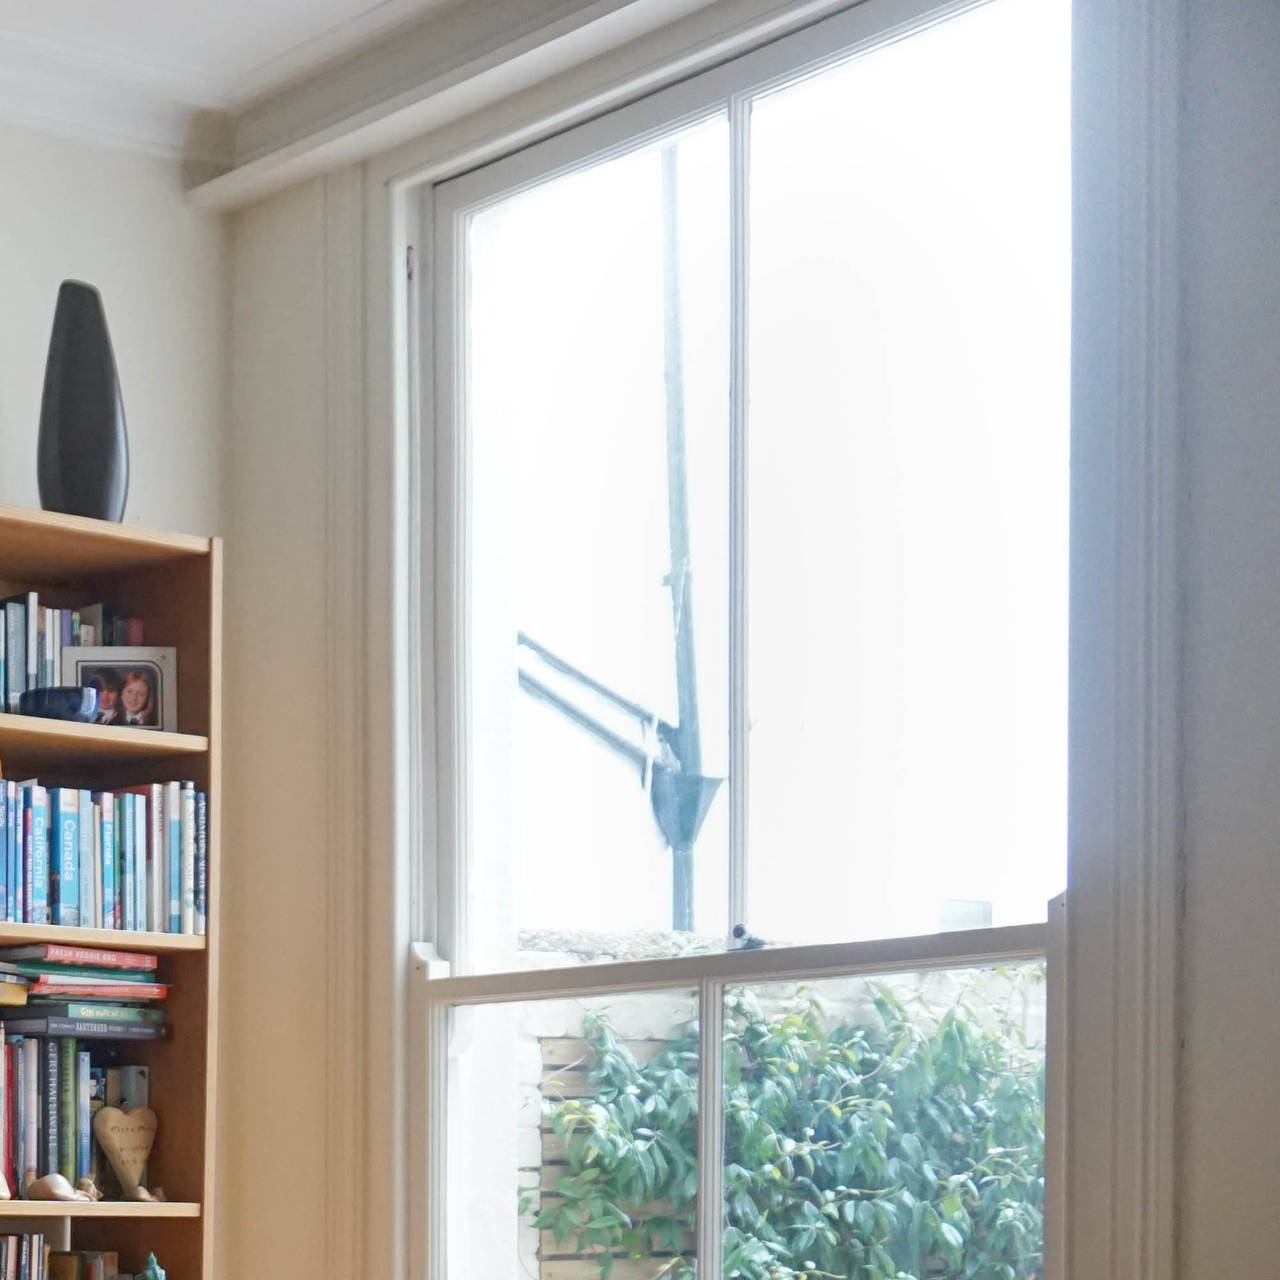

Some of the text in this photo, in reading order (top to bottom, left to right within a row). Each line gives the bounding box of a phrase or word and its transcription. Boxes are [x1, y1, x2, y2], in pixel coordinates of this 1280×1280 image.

[34, 817, 45, 888] California
[63, 819, 77, 881] Canada
[104, 823, 113, 865] Florida
[48, 1042, 57, 1148] GERI HALLIWELL
